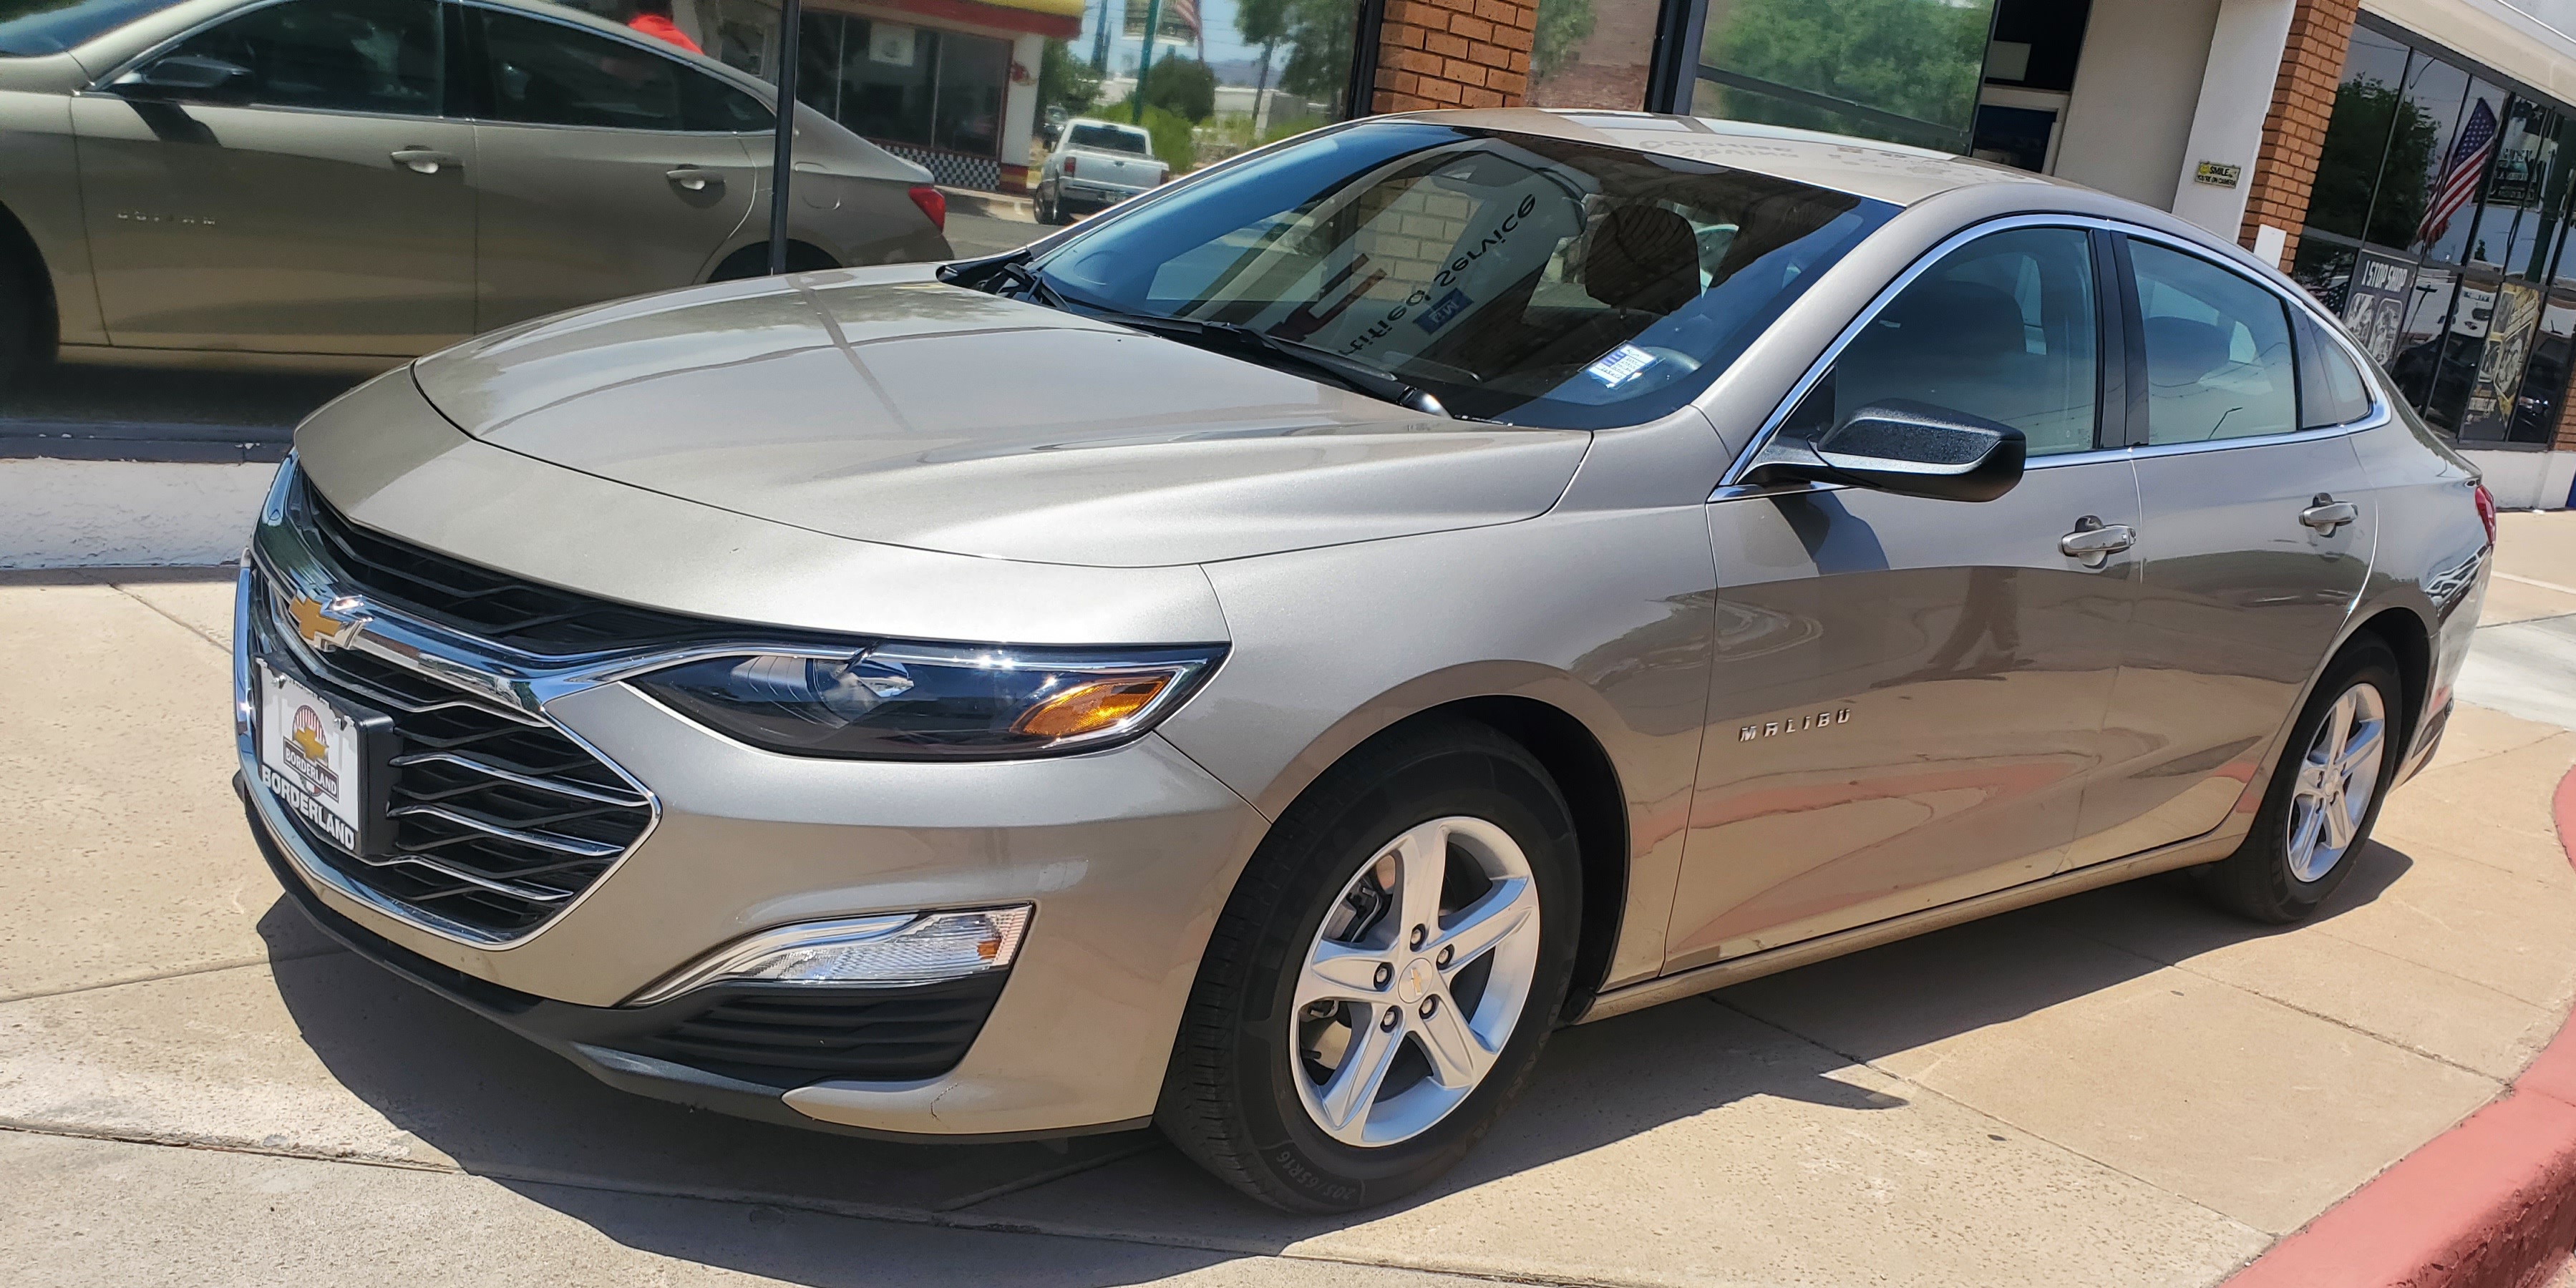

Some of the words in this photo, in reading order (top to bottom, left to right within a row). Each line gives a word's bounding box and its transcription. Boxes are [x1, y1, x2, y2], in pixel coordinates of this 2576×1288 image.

[2366, 261, 2389, 288] STOP
[2384, 265, 2408, 293] SHOP
[1739, 708, 1851, 742] MALIBU
[285, 748, 337, 795] BORDERLAND
[263, 766, 354, 851] BORDERLAND
